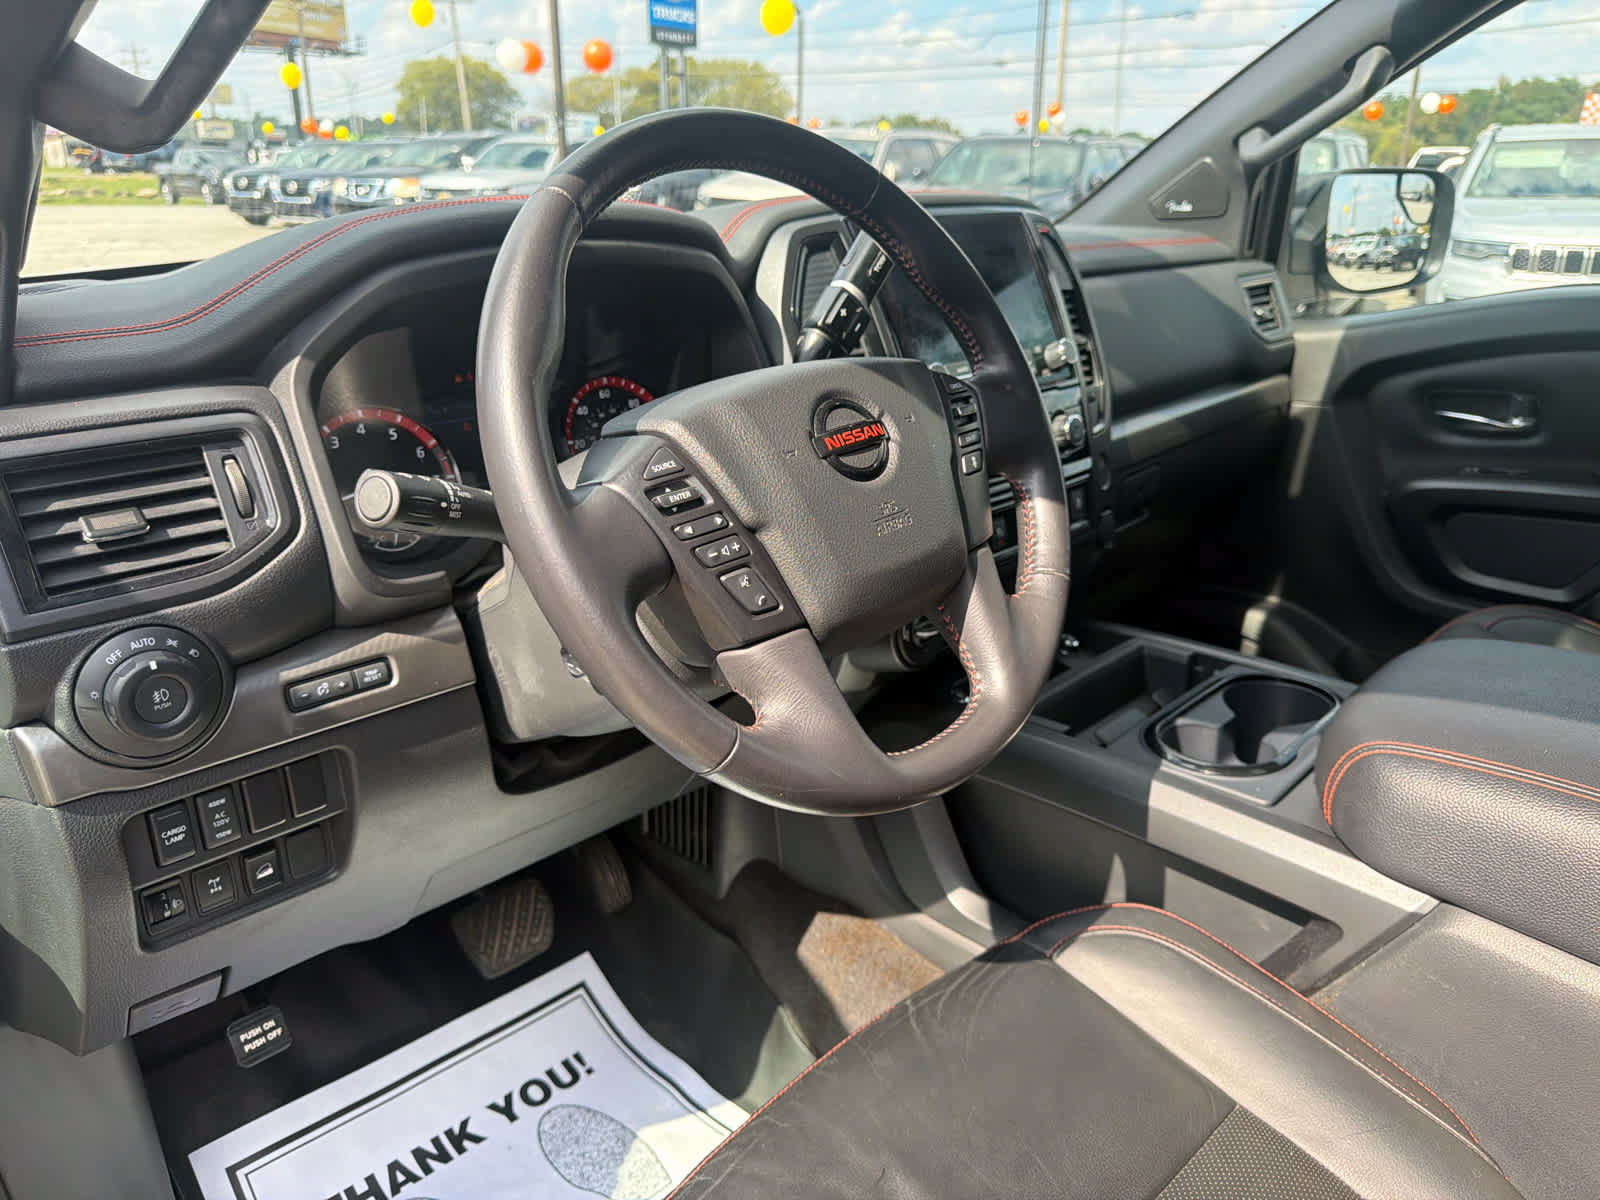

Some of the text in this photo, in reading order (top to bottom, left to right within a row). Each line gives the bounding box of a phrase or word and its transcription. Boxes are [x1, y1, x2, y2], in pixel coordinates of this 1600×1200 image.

[356, 423, 366, 435] 4
[388, 428, 398, 441] 5
[331, 436, 340, 449] 3
[824, 423, 885, 451] NISSAN
[416, 446, 425, 459] 6
[651, 460, 677, 472] SOURCE
[669, 490, 692, 503] ENTER
[130, 637, 156, 651] AUTO
[105, 648, 123, 665] OFF
[161, 824, 187, 838] CARGO
[165, 833, 186, 846] LAMP
[240, 1019, 276, 1043] PUSH ON
[243, 1027, 283, 1053] PUSH OFF
[325, 1051, 595, 1200] HANK YOU!
